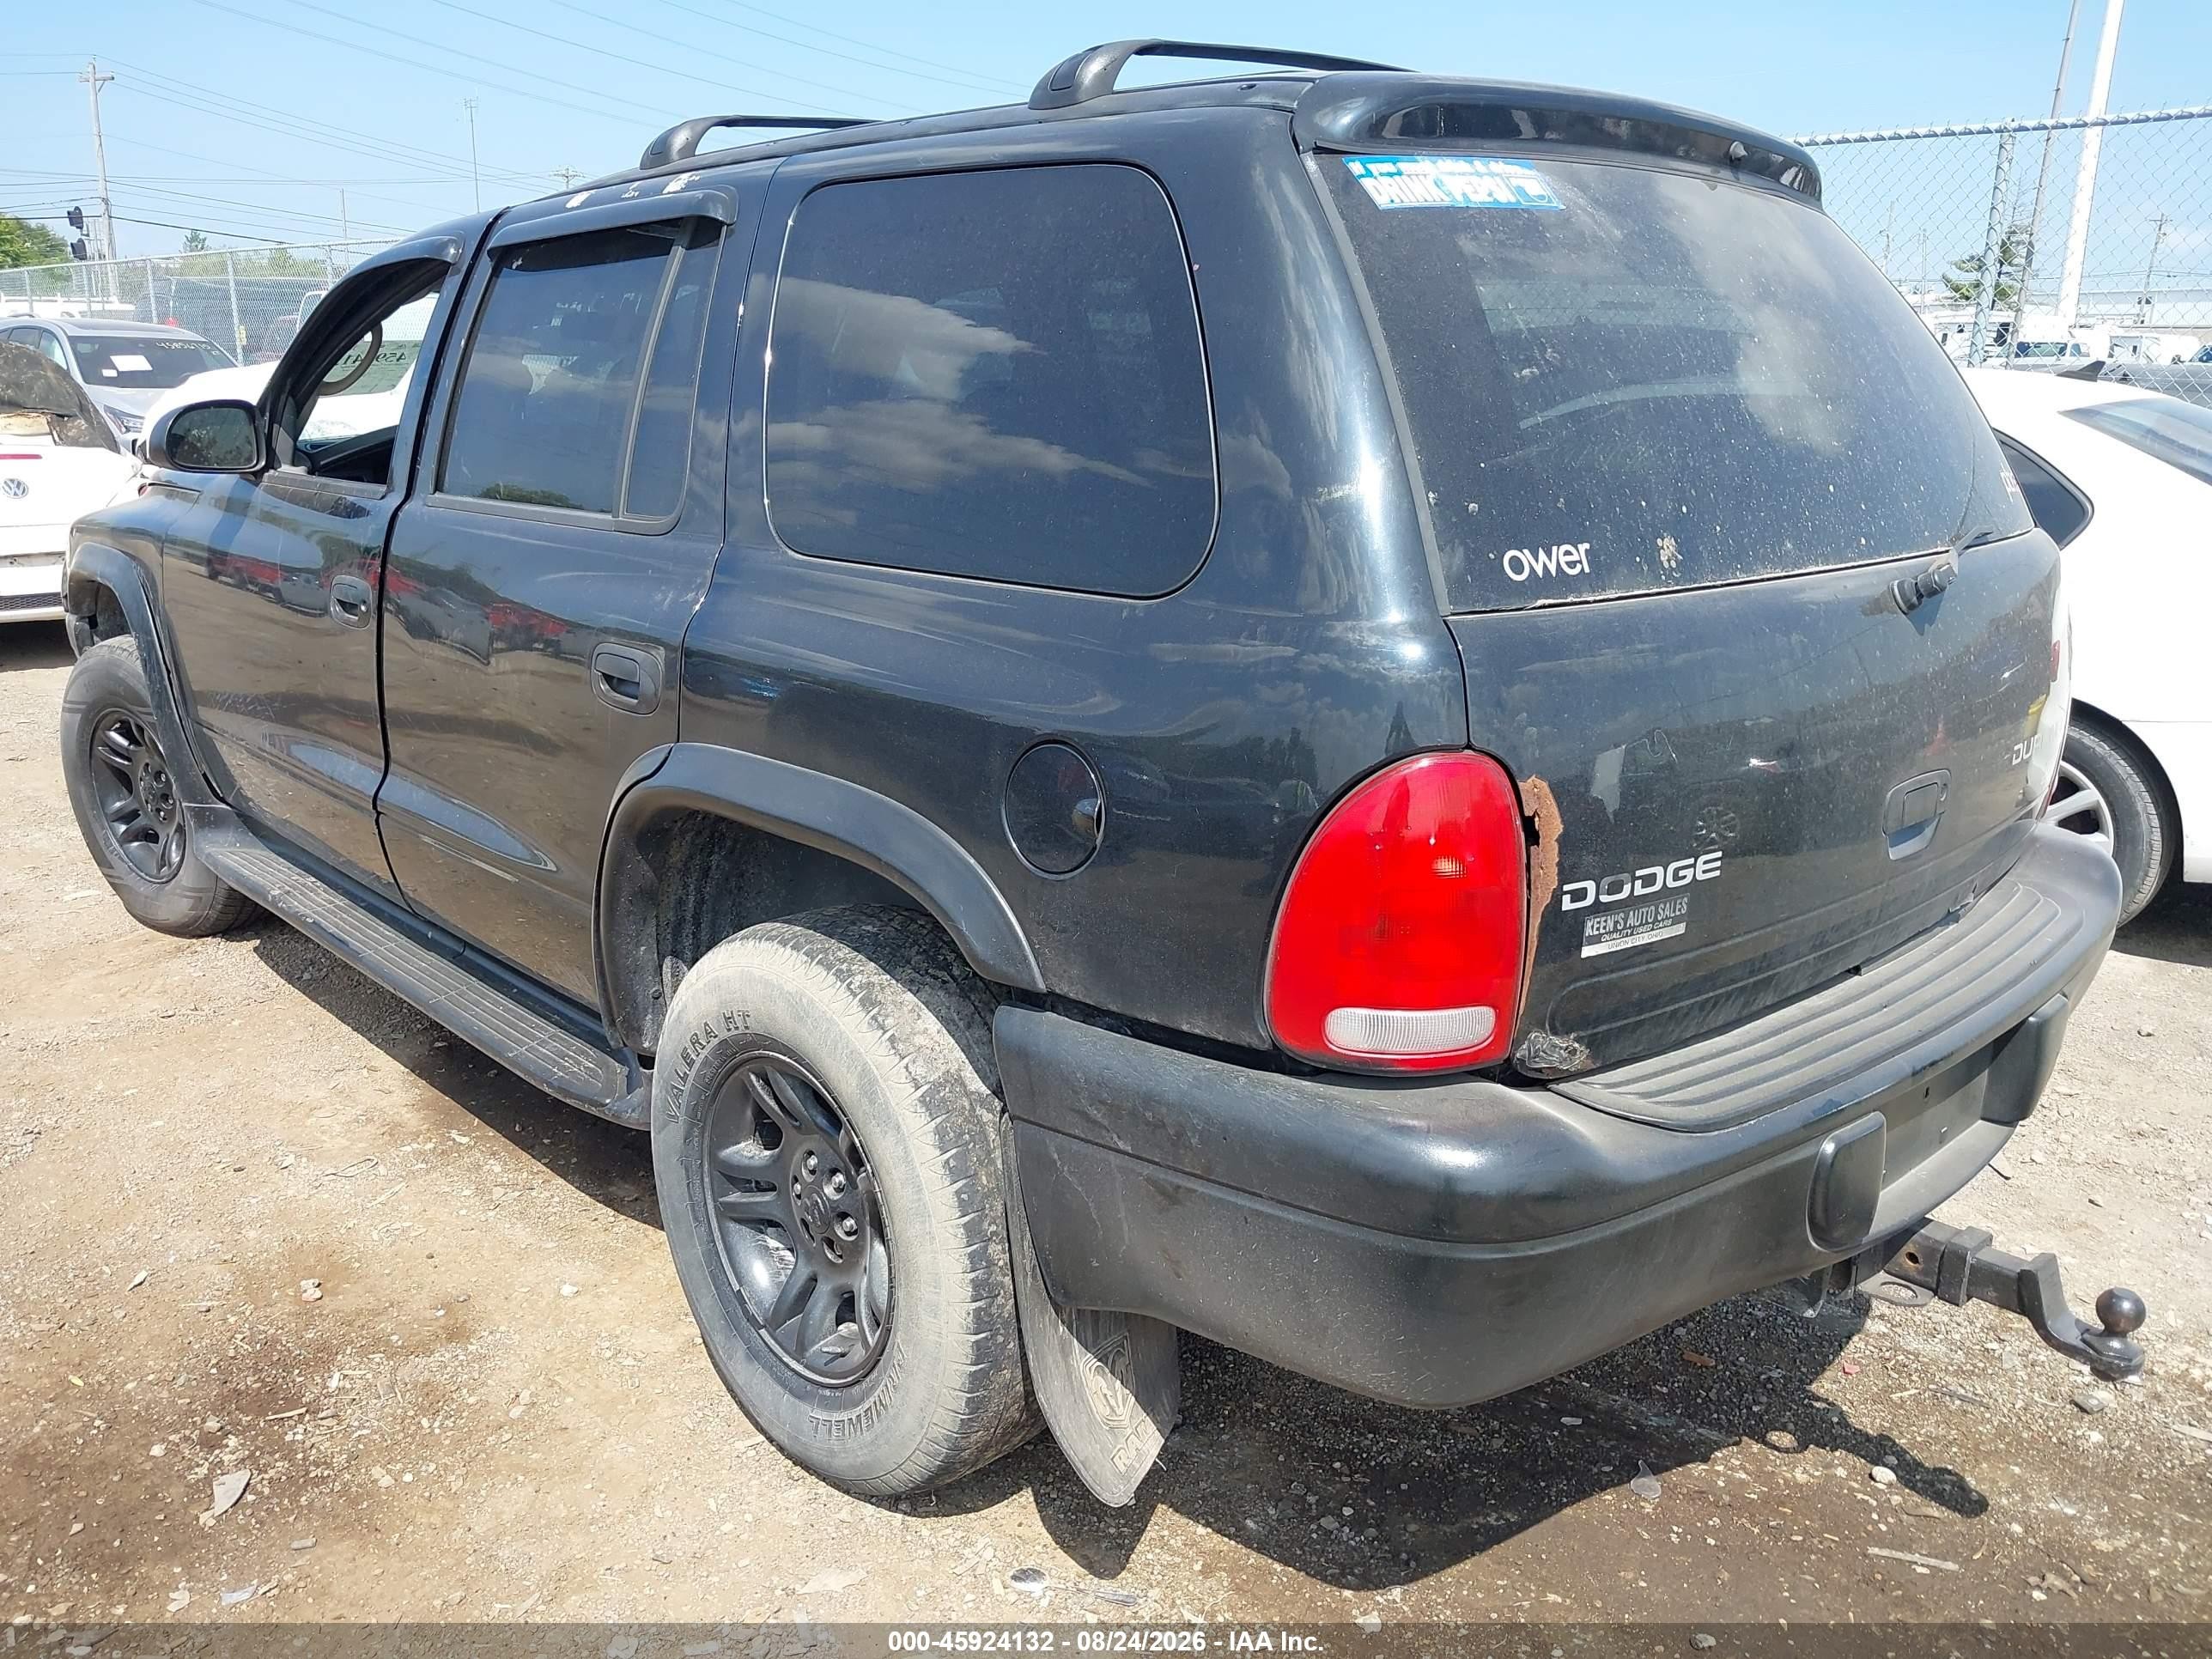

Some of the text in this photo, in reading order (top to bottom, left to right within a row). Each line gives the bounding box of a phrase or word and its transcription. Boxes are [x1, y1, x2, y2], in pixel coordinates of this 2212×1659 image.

[1360, 174, 1450, 204] DRINK
[1503, 542, 1590, 581] ower
[1561, 851, 1723, 911] DODGE
[1585, 897, 1689, 937] KEEN'S AUTO SALES
[1601, 918, 1673, 942] QUALITY USED CARS
[1607, 939, 1630, 950] UNION
[1647, 931, 1663, 940] OHIO
[665, 1021, 719, 1124] VALERA
[722, 1009, 750, 1032] HT
